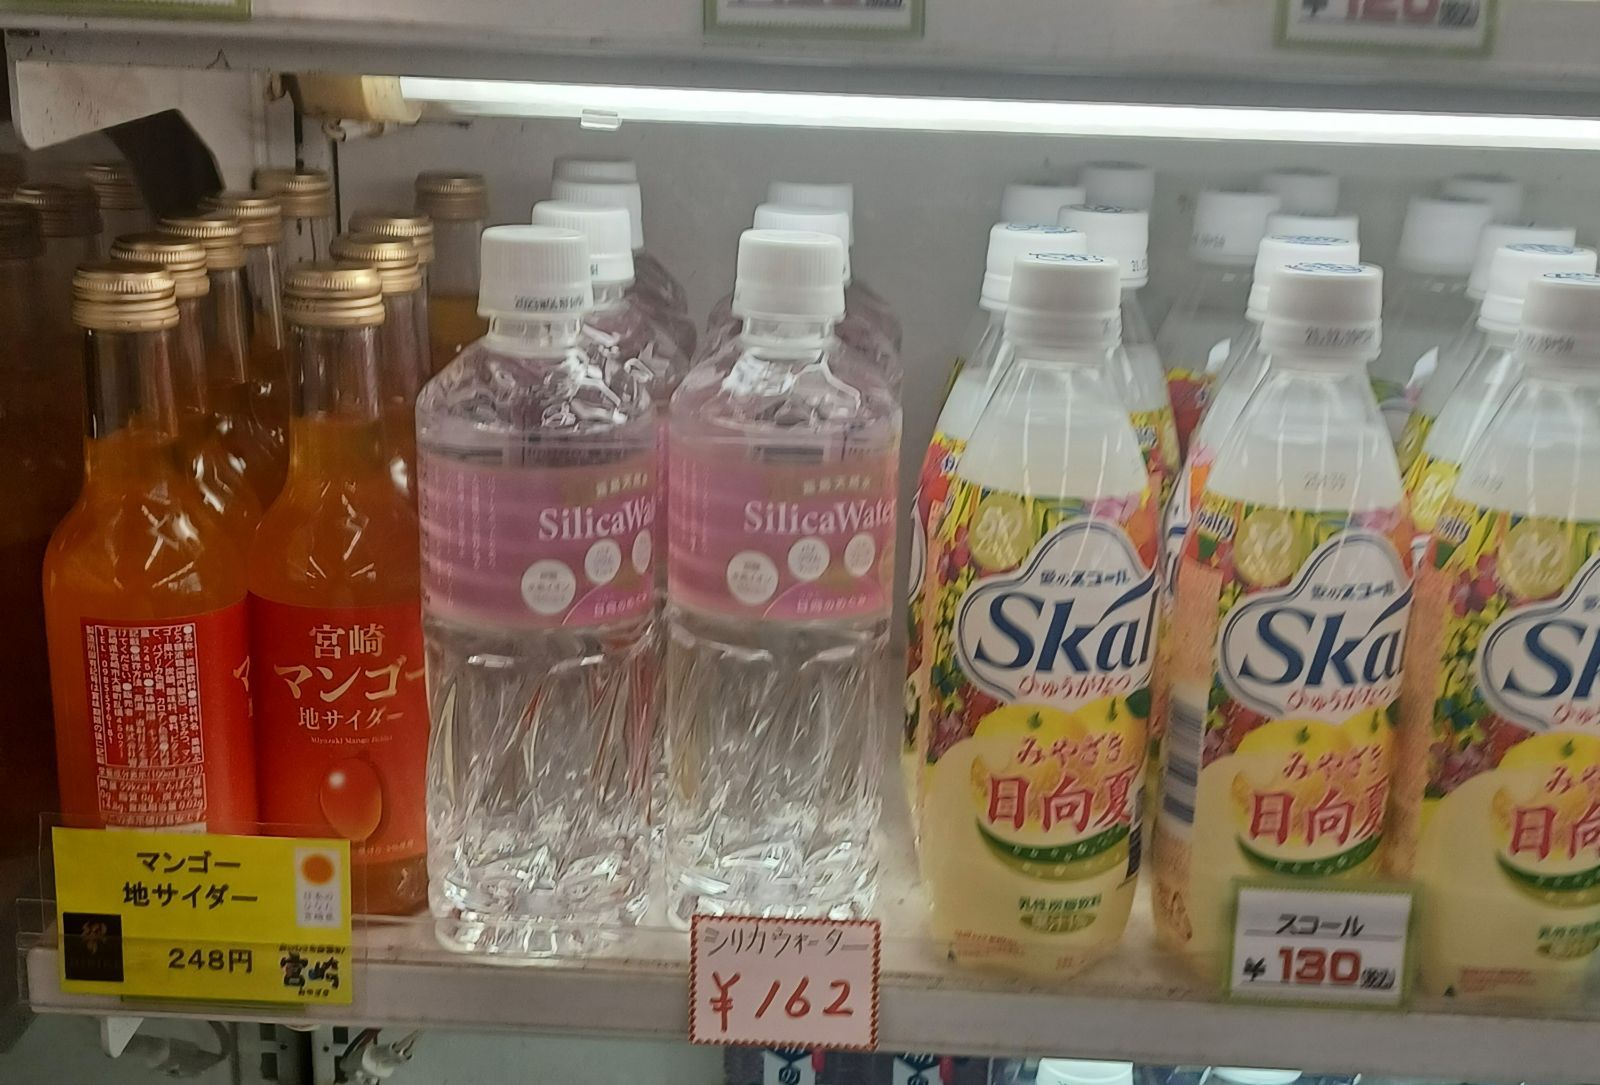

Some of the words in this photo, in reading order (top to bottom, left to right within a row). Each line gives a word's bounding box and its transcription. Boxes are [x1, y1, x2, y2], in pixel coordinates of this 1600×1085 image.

[308, 623, 385, 659] 宮崎
[274, 655, 425, 702] マンゴー
[299, 705, 404, 731] 地サイダー
[987, 766, 1136, 833] 日向夏
[136, 852, 241, 873] マンゴー
[123, 881, 258, 909] 地サイダー
[1276, 913, 1365, 937] スコール
[168, 947, 252, 973] 248円
